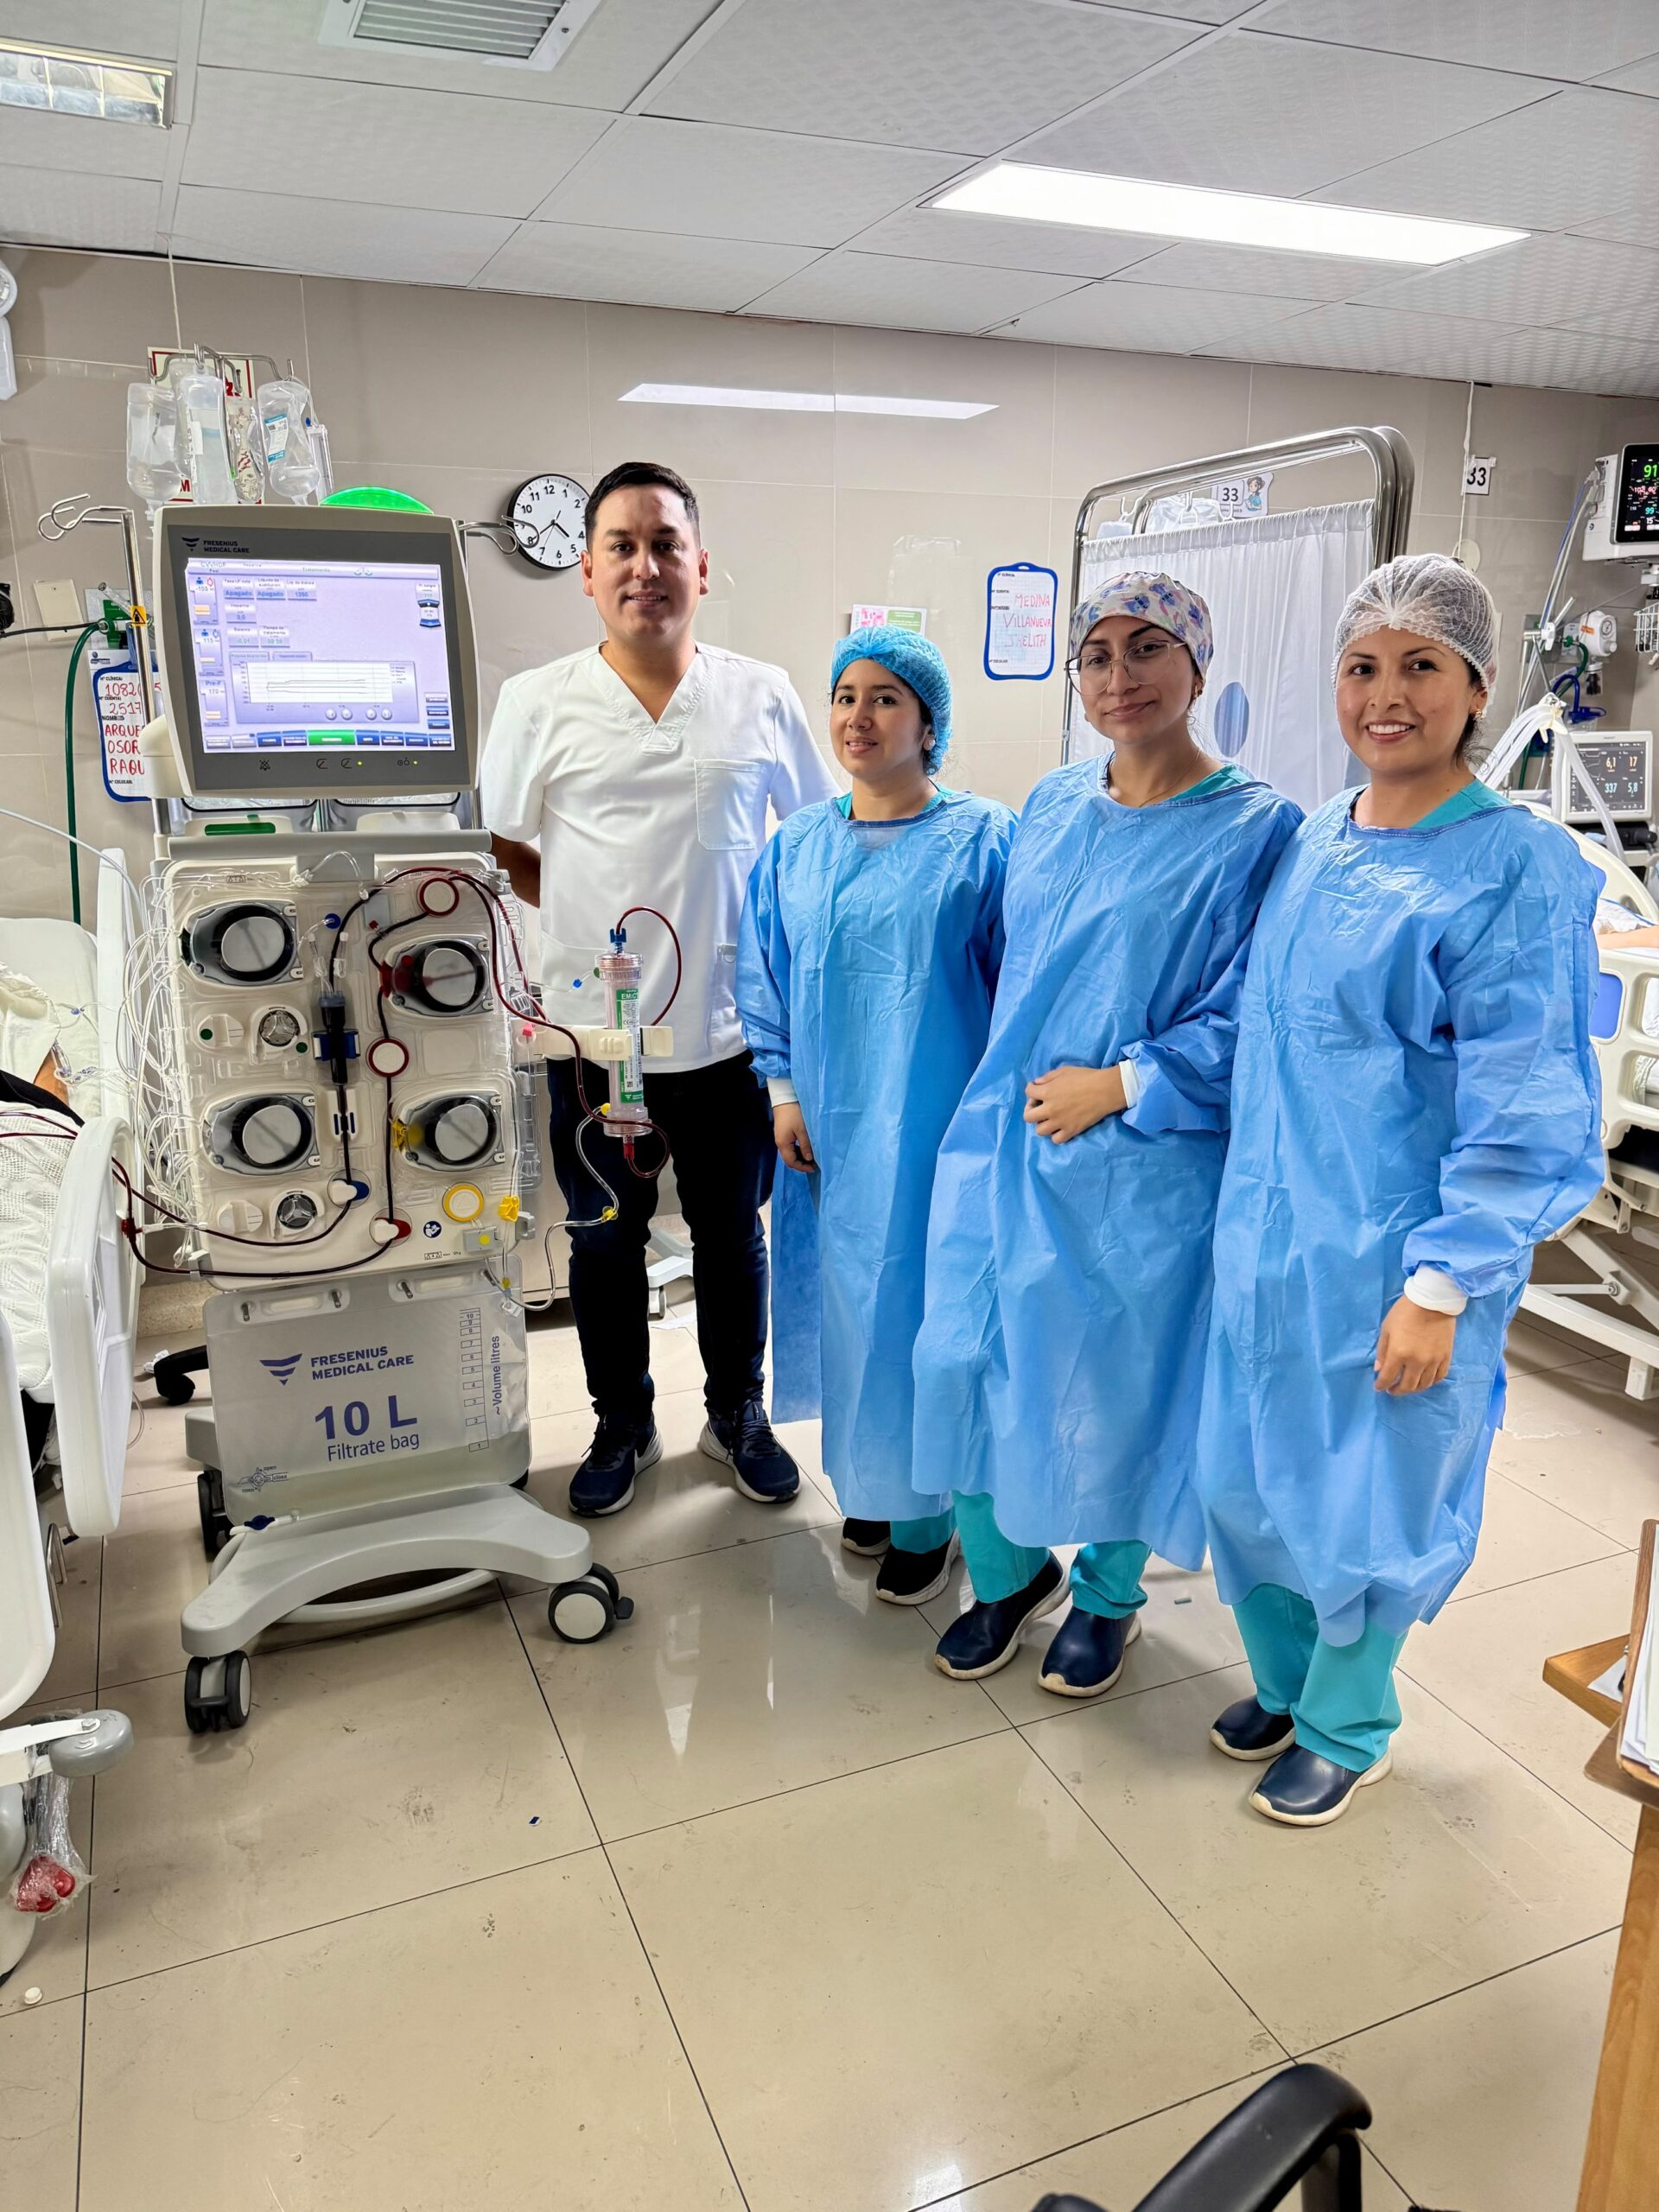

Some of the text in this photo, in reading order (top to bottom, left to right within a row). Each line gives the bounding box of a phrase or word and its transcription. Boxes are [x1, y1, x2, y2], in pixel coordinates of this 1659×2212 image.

[1466, 467, 1486, 486] 33
[1643, 465, 1657, 478] 91
[543, 485, 555, 494] 12
[563, 489, 568, 498] 1
[1222, 487, 1238, 501] 33
[530, 492, 540, 501] 11
[521, 505, 532, 513] 10
[575, 499, 581, 508] 2
[528, 536, 534, 545] 8
[578, 531, 585, 539] 4
[539, 546, 545, 556] 7
[570, 543, 576, 553] 5
[556, 550, 562, 558] 6
[105, 723, 145, 737] ARQUE
[110, 758, 145, 775] RAQU
[1605, 756, 1617, 769] 6,1
[1629, 756, 1637, 767] 17
[1605, 783, 1618, 793] 337
[1627, 782, 1638, 794] 5,8
[491, 1335, 501, 1363] litres
[311, 1346, 388, 1367] FRESENIUS
[312, 1355, 414, 1380] MEDICAL CARE
[315, 1395, 417, 1440] 10 L
[327, 1433, 419, 1462] Filtrate bag
